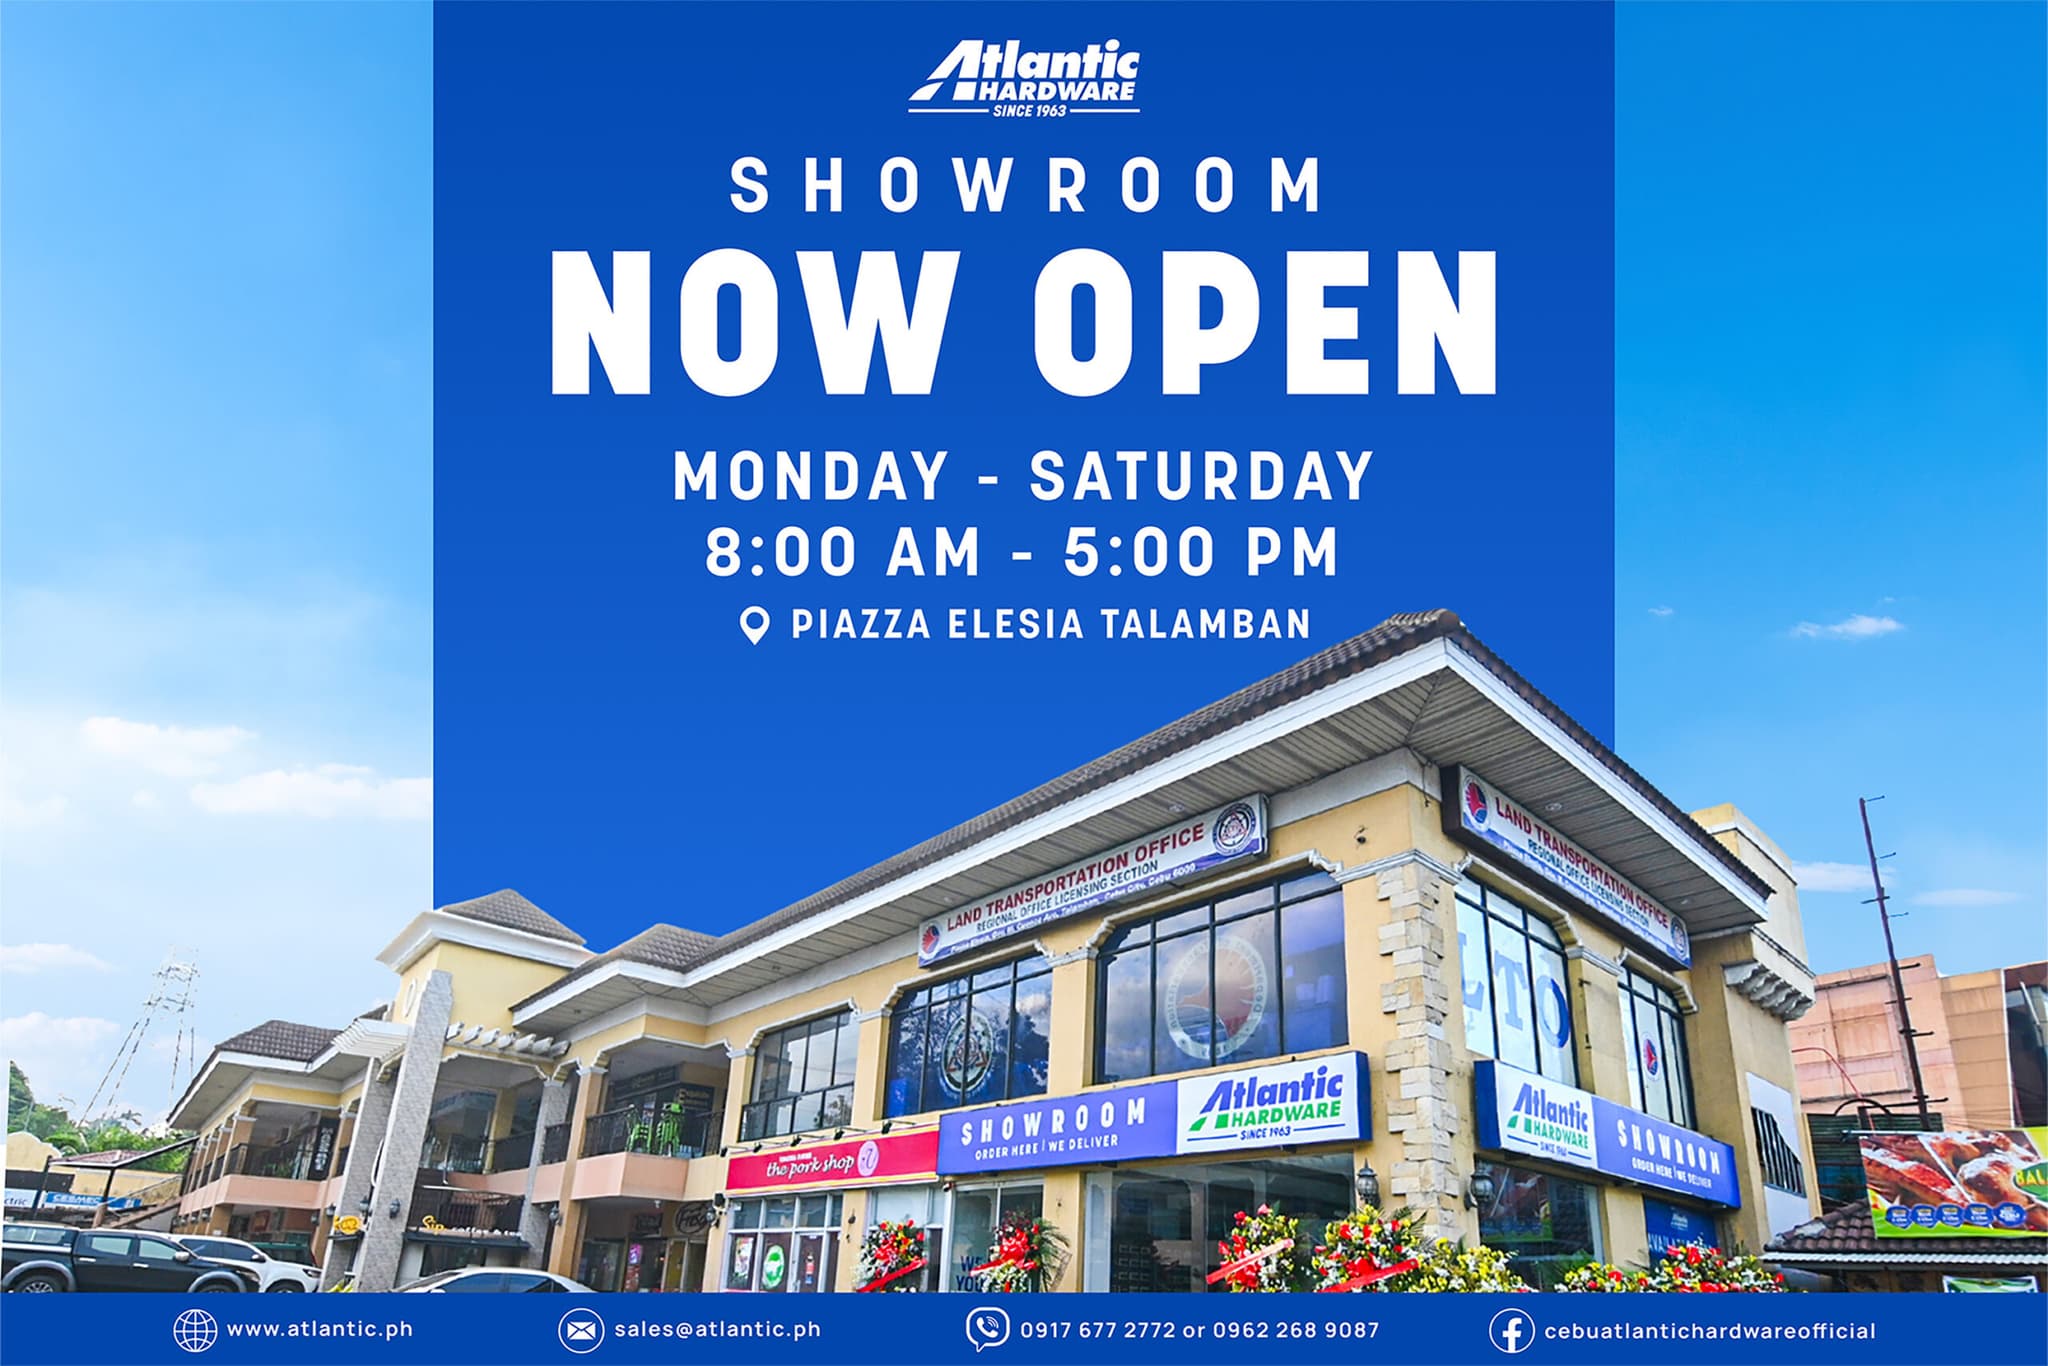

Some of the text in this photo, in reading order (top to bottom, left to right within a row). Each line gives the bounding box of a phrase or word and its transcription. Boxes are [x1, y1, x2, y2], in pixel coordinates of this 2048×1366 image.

[947, 907, 982, 931] LAND
[985, 851, 1130, 917] TRANSPORTATION
[1134, 822, 1205, 862] OFFICE
[1495, 796, 1669, 930] LAND TRANSPORTATION OFFICE
[976, 859, 1158, 933] REGIONAL OFFICE LICENSING SECTION
[1200, 1065, 1344, 1114] Atlantic
[1512, 1082, 1588, 1133] Atlantic
[961, 1097, 1145, 1146] SHOWROOM
[1231, 1100, 1341, 1127] HARDWARE
[1239, 1125, 1292, 1141] SINCE 1963
[975, 1134, 1119, 1161] ORDER HERE WE DELIVER
[1534, 1119, 1589, 1149] HARDWARE
[1617, 1119, 1720, 1176] SHOWROOM
[766, 1161, 788, 1177] the
[788, 1156, 822, 1180] pork
[823, 1154, 855, 1175] shop
[1632, 1156, 1712, 1188] ORDER HERE WE DELIVER
[422, 1215, 445, 1236] Sip
